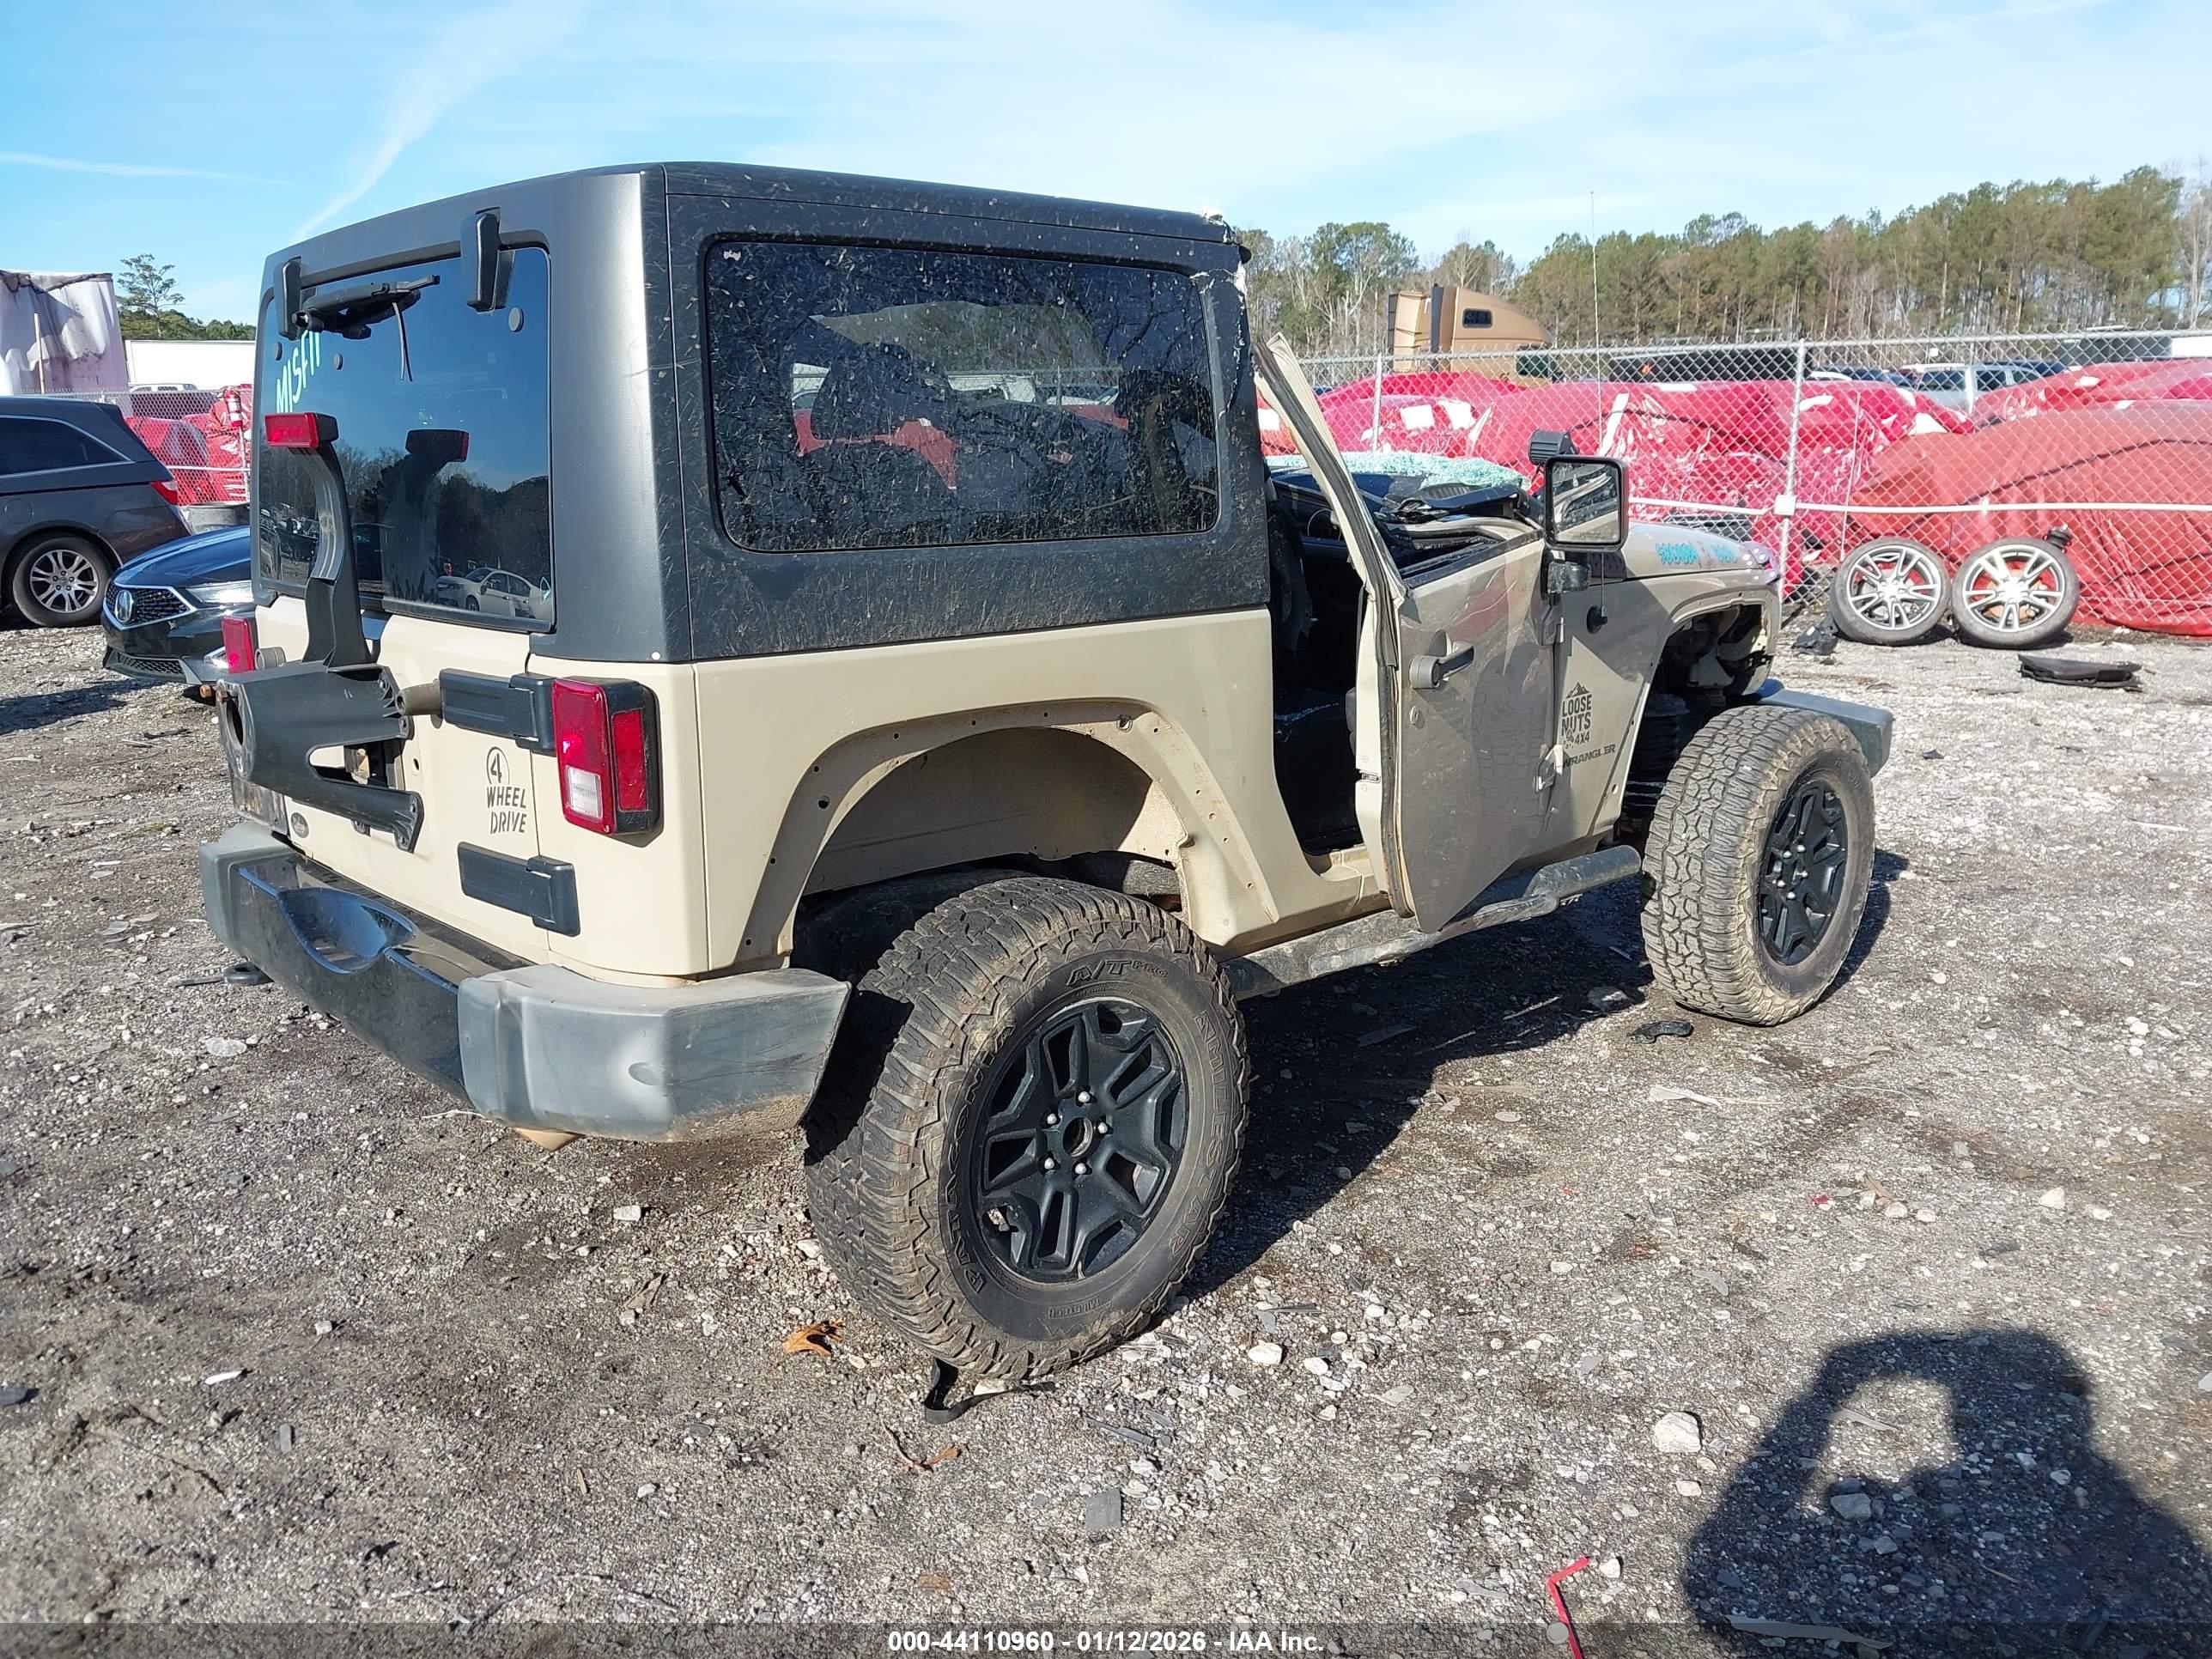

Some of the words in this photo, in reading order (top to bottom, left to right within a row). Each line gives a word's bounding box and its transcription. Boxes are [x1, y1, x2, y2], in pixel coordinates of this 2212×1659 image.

[1562, 694, 1592, 717] LOOSE
[1561, 712, 1591, 737] NUTS
[1575, 730, 1590, 745] 4X4
[489, 752, 502, 784] 4
[1563, 744, 1616, 769] WRANGLER
[487, 786, 526, 808] WHEEL
[490, 811, 527, 834] DRIVE
[1066, 959, 1132, 986] A/T
